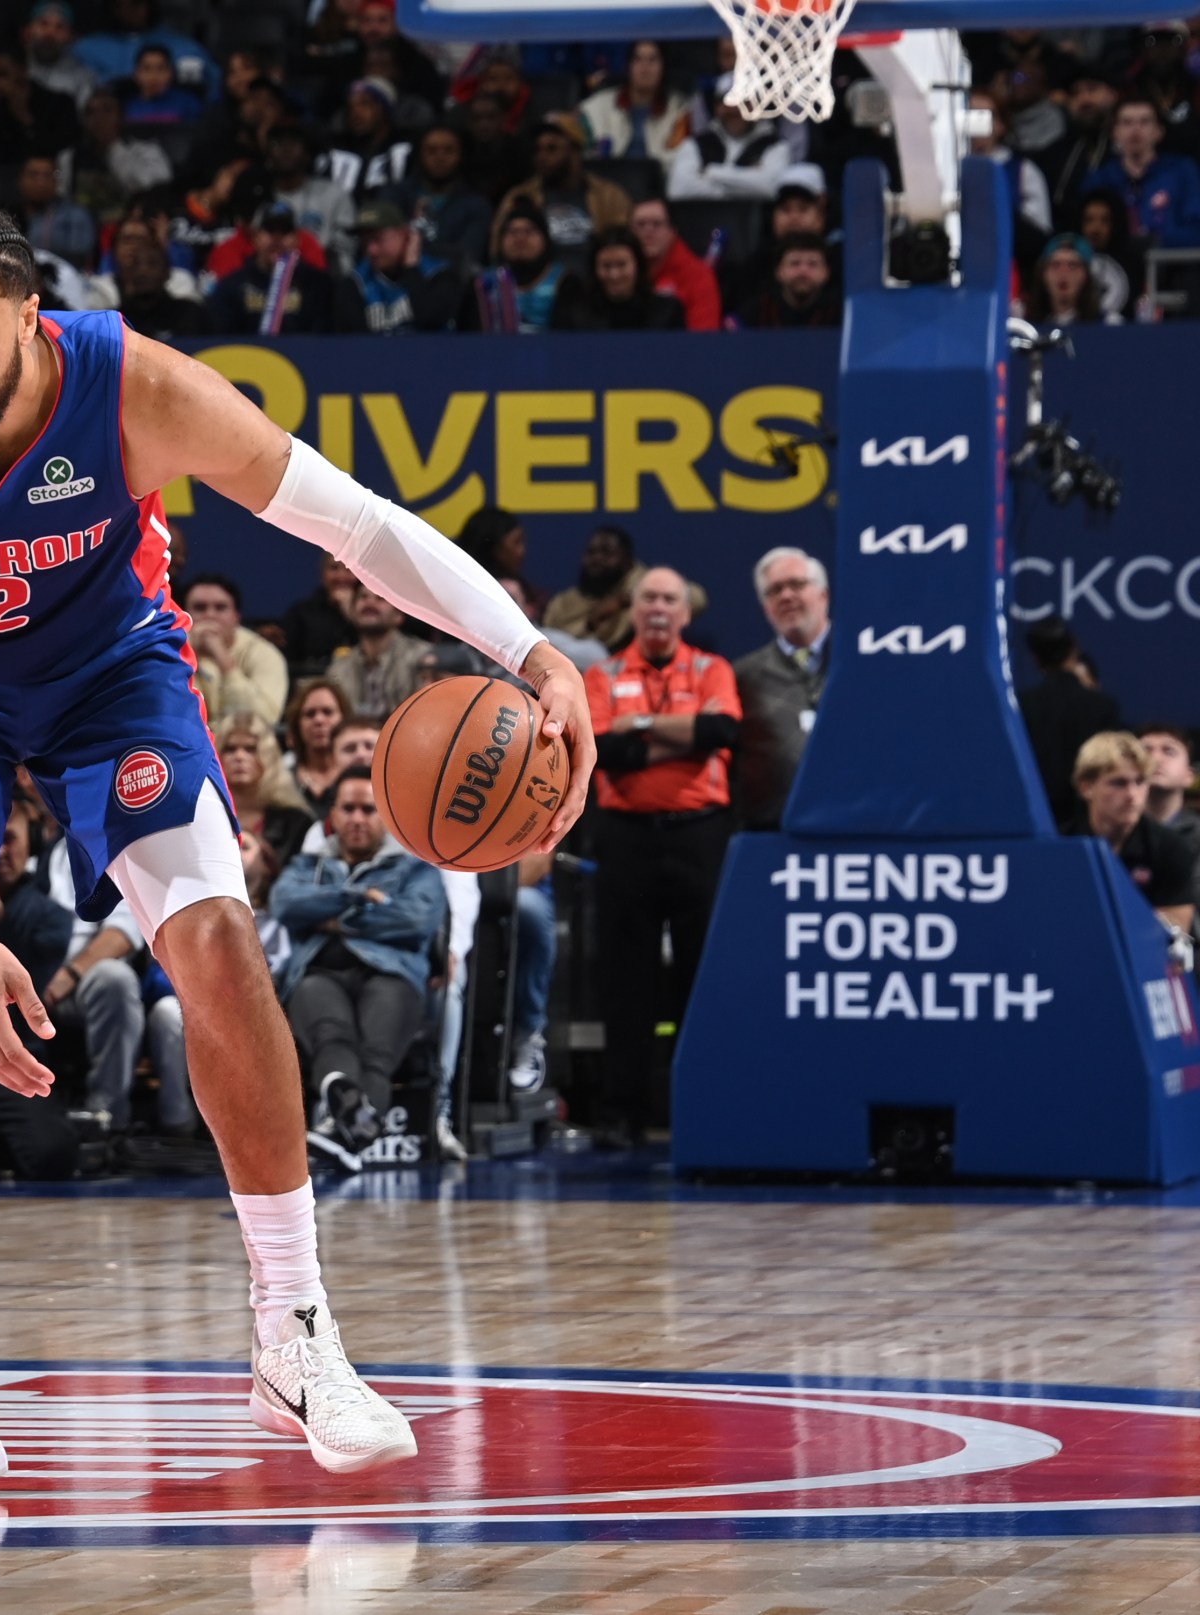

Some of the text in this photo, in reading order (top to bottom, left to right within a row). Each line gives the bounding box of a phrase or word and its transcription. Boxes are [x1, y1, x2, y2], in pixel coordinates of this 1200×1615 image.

[30, 479, 92, 502] StockX
[122, 764, 158, 785] DETROIT
[123, 774, 160, 796] PISTONS
[443, 705, 521, 826] Wilson
[770, 853, 1009, 903] HENRY
[785, 911, 958, 961] FORD
[785, 970, 1054, 1022] HEALTH
